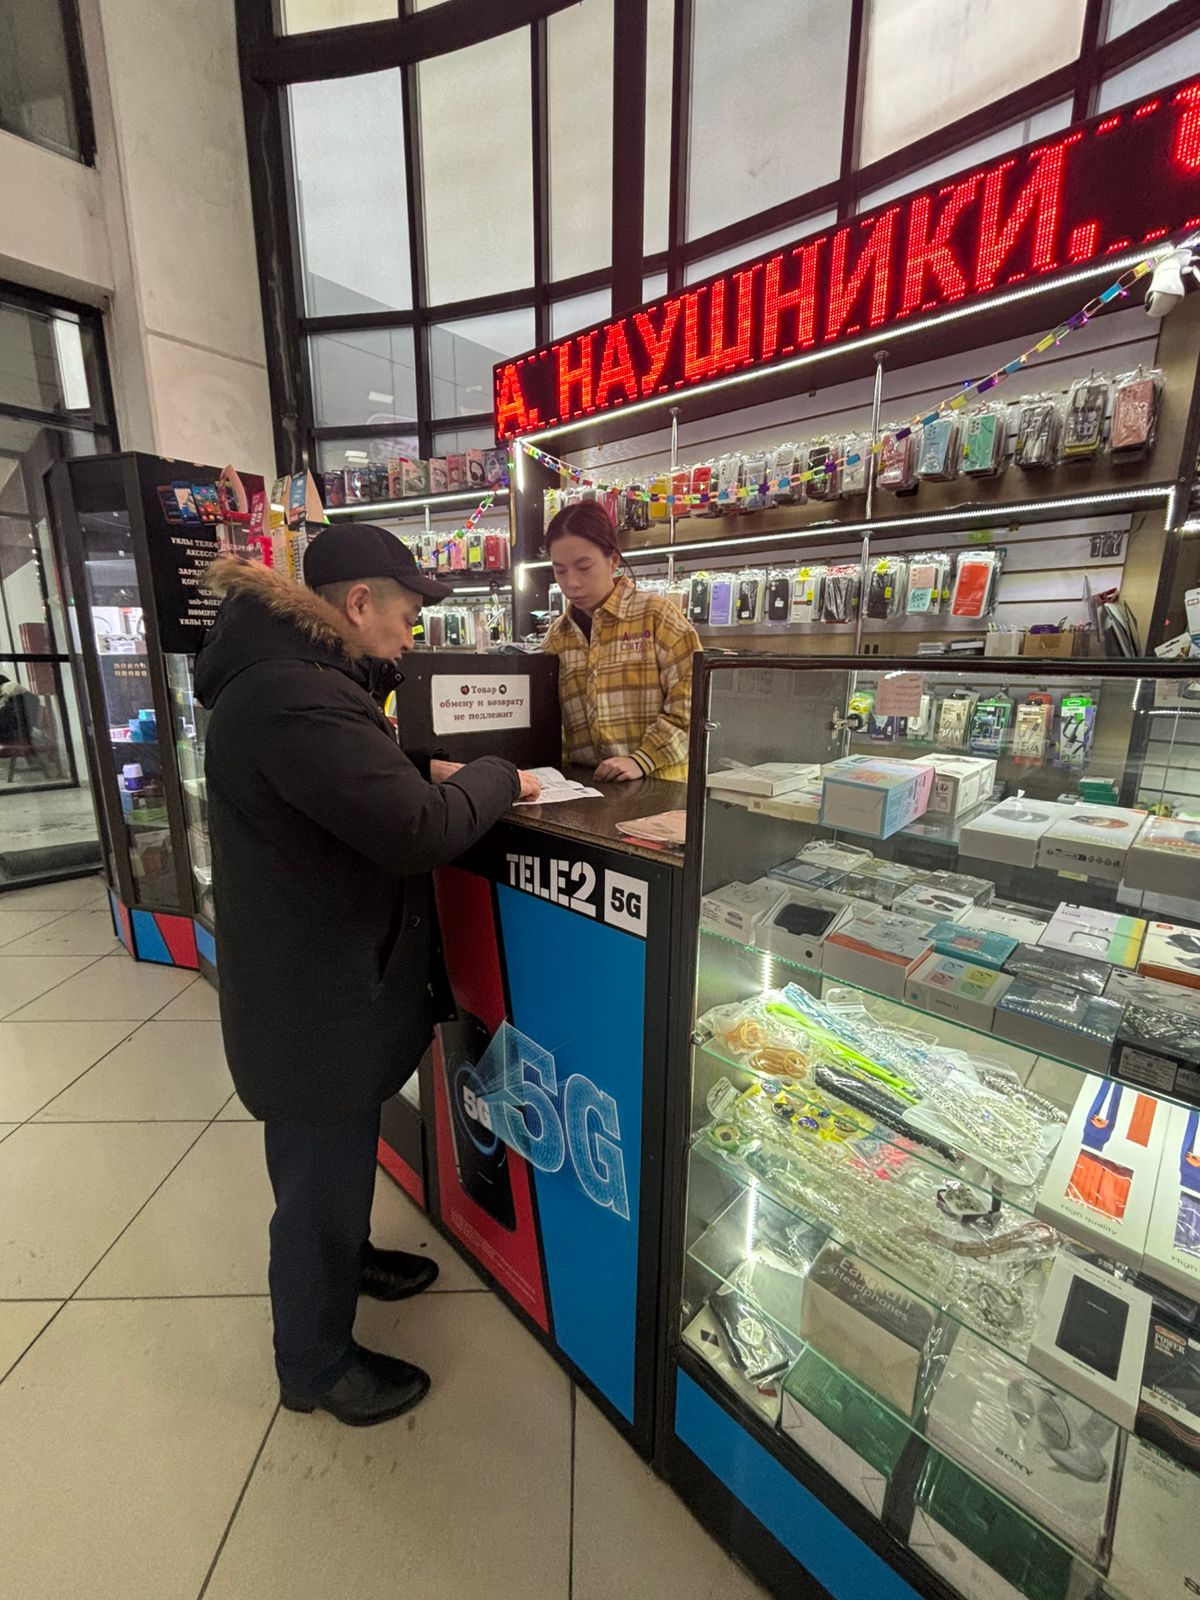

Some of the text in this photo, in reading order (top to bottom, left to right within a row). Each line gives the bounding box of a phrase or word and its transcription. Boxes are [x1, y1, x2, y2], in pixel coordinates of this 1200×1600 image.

[557, 142, 1097, 419] НАУШНИКИ.
[439, 699, 475, 709] обмену
[487, 697, 525, 708] возврату
[471, 685, 498, 695] Товар
[468, 710, 514, 721] подлежит
[506, 853, 642, 920] TELE2 5G
[463, 1085, 492, 1131] 5G
[503, 1017, 631, 1221] 5G
[1084, 1213, 1118, 1236] quality
[833, 1268, 909, 1321] Headphones
[995, 1446, 1033, 1477] SONY
